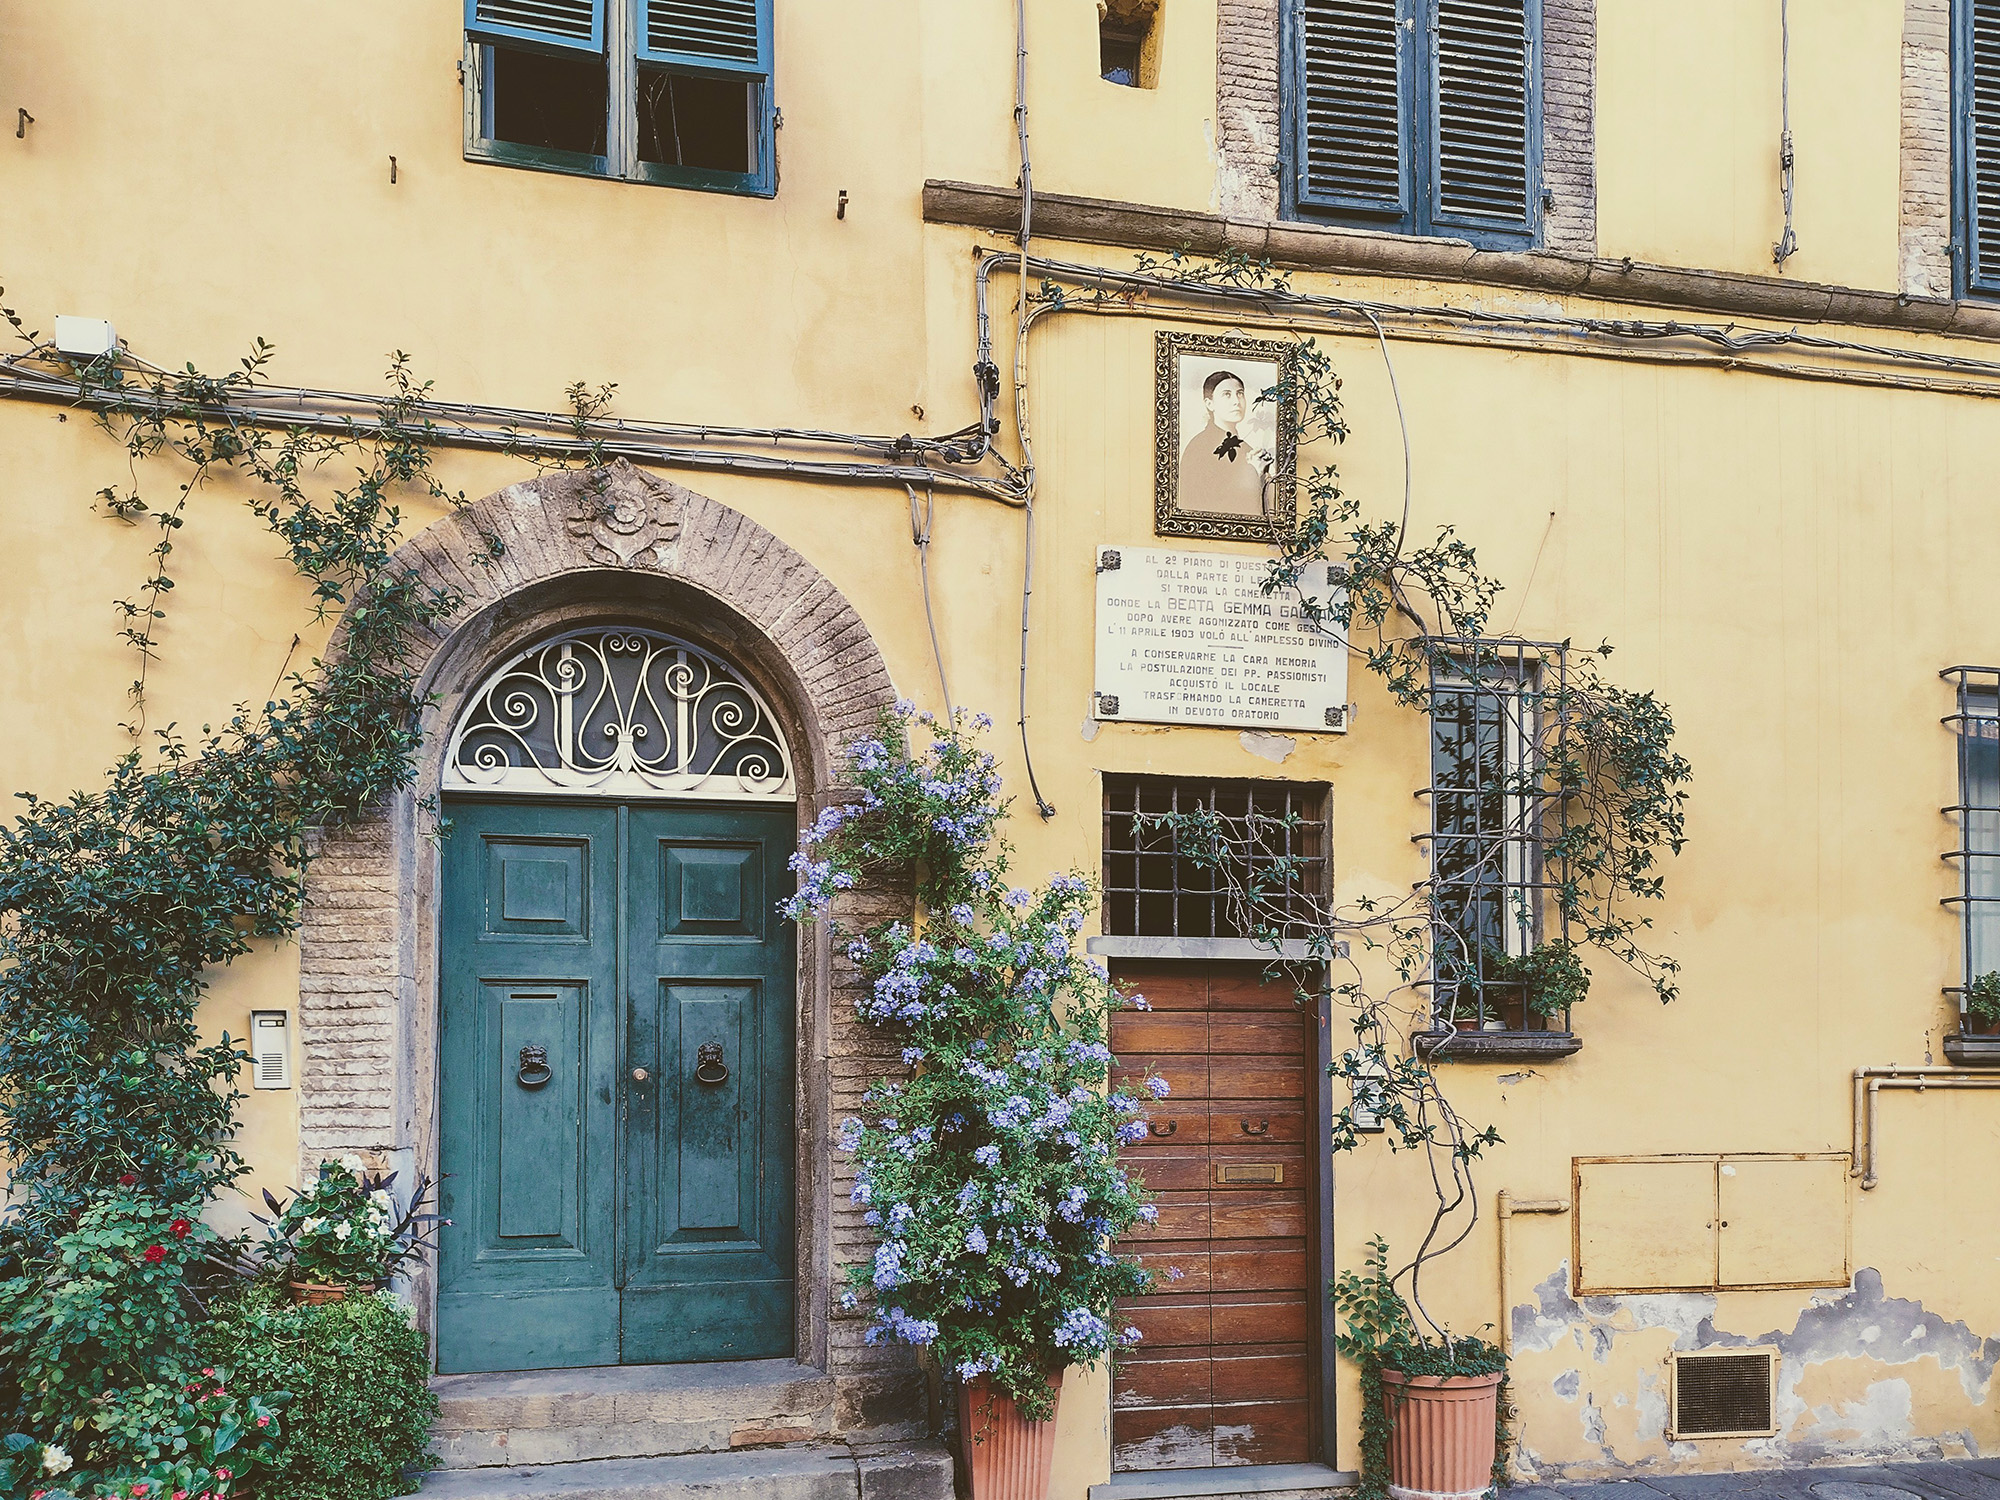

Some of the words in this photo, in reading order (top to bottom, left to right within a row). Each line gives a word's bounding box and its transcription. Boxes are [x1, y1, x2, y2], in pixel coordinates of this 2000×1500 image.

[1146, 556, 1158, 564] AL
[1184, 558, 1213, 568] PIANO
[1220, 560, 1229, 569] DI
[1157, 570, 1189, 579] DALLA
[1196, 572, 1228, 582] PARTE
[1235, 574, 1244, 583] DI
[1161, 584, 1170, 592] SI
[1177, 585, 1207, 595] TROVA
[1216, 587, 1228, 596] LA
[1107, 598, 1140, 608] DONDE
[1168, 598, 1214, 612] BEATA
[1224, 602, 1272, 617] GEMMA
[1128, 613, 1153, 622] DOPO
[1161, 615, 1192, 624] AVERE
[1199, 617, 1258, 629] AGONIZZATO
[1266, 621, 1291, 631] COME
[1131, 627, 1166, 637] APRILE
[1171, 629, 1195, 639] 1903
[1254, 634, 1304, 645] AMPLESSO
[1309, 638, 1339, 648] DIVINO
[1132, 649, 1137, 657] A
[1144, 649, 1216, 661] CONSERVARNE
[1223, 654, 1235, 662] LA
[1243, 655, 1268, 664] CARA
[1275, 657, 1317, 668] MEMORIA
[1120, 663, 1133, 671] LA
[1141, 663, 1214, 675] POSTULAZIONE
[1221, 667, 1237, 676] DEI
[1244, 669, 1260, 678] PP.
[1267, 671, 1327, 682] PASSIONISTI
[1225, 681, 1234, 690] IL
[1241, 682, 1280, 693] LOCALE
[1143, 691, 1222, 703] TRASFORMANDO
[1229, 695, 1241, 704] LA
[1248, 696, 1306, 708] CAMERETTA
[1169, 706, 1178, 715] IN
[1185, 707, 1224, 717] DEVOTO
[1232, 709, 1279, 720] ORATORIO
